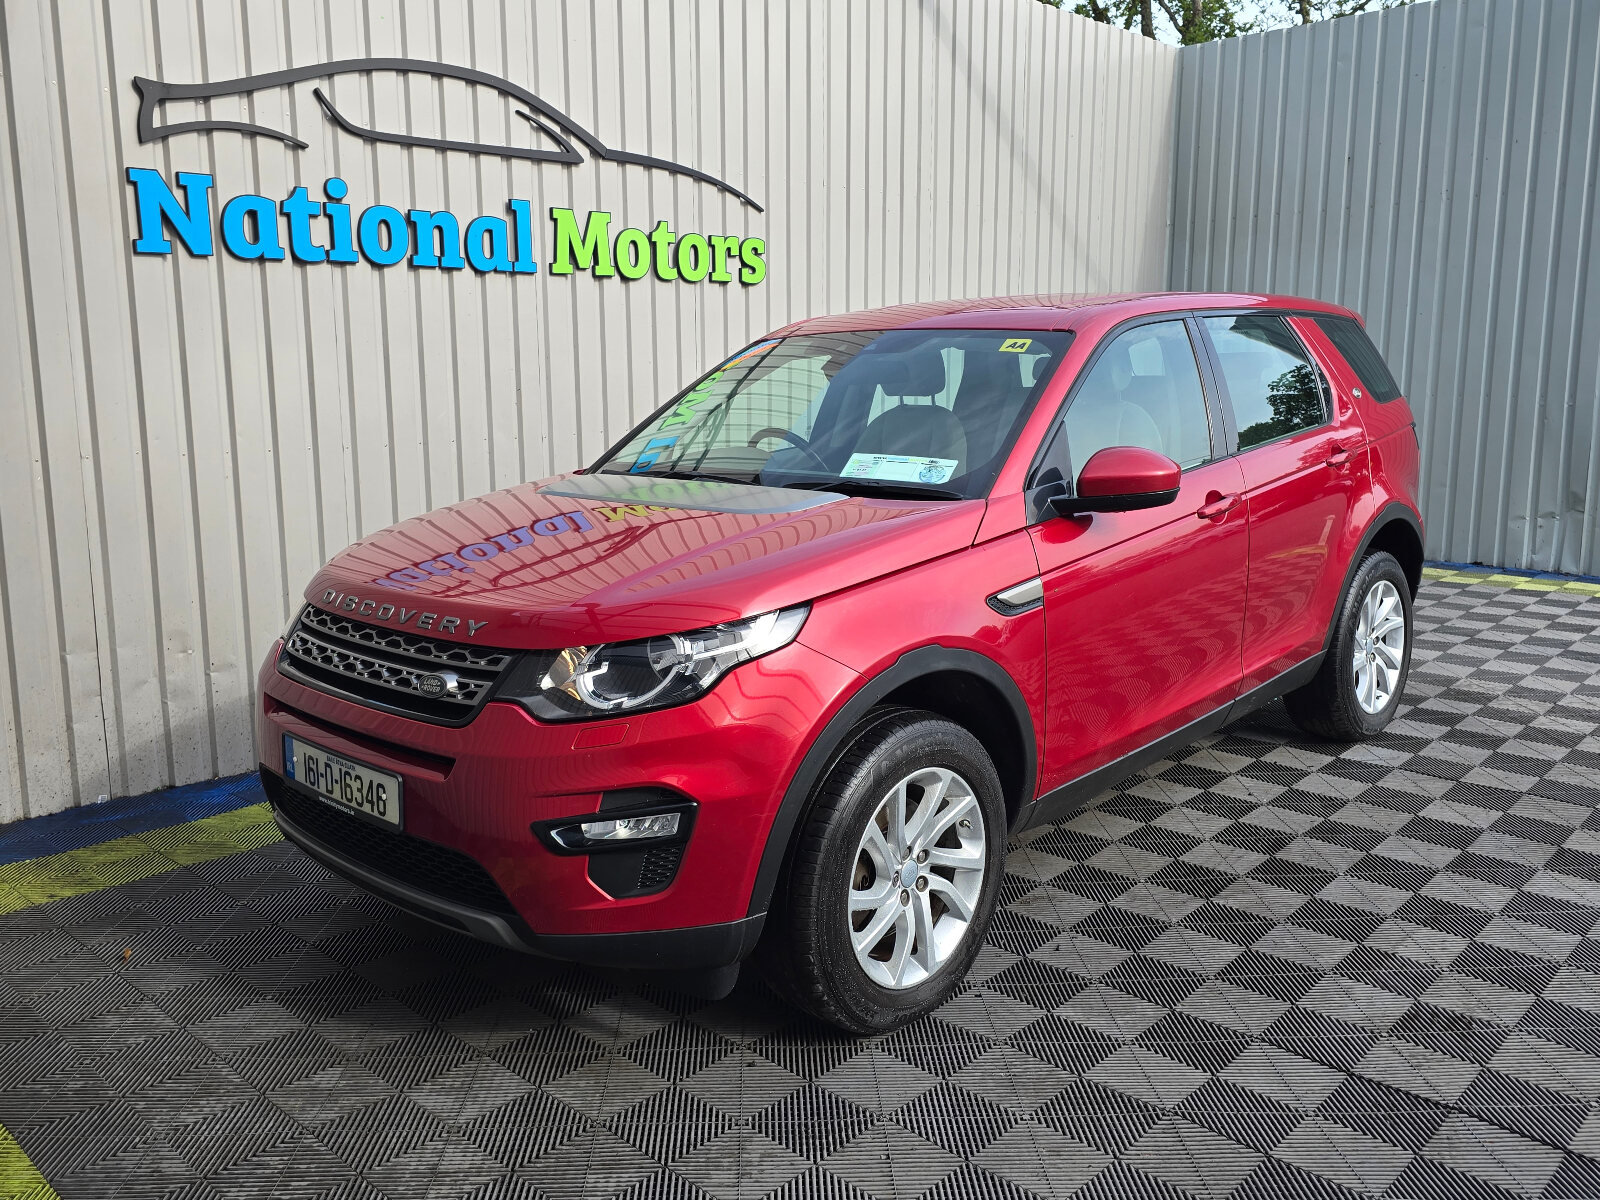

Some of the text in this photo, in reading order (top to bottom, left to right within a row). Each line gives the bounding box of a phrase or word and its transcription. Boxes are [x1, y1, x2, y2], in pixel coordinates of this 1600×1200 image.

[126, 167, 767, 285] National Motors
[1006, 341, 1027, 350] AA
[322, 589, 488, 636] DISCOVERY
[423, 684, 441, 693] ROVER
[424, 678, 438, 686] LAND
[303, 752, 387, 817] 161-D-16346
